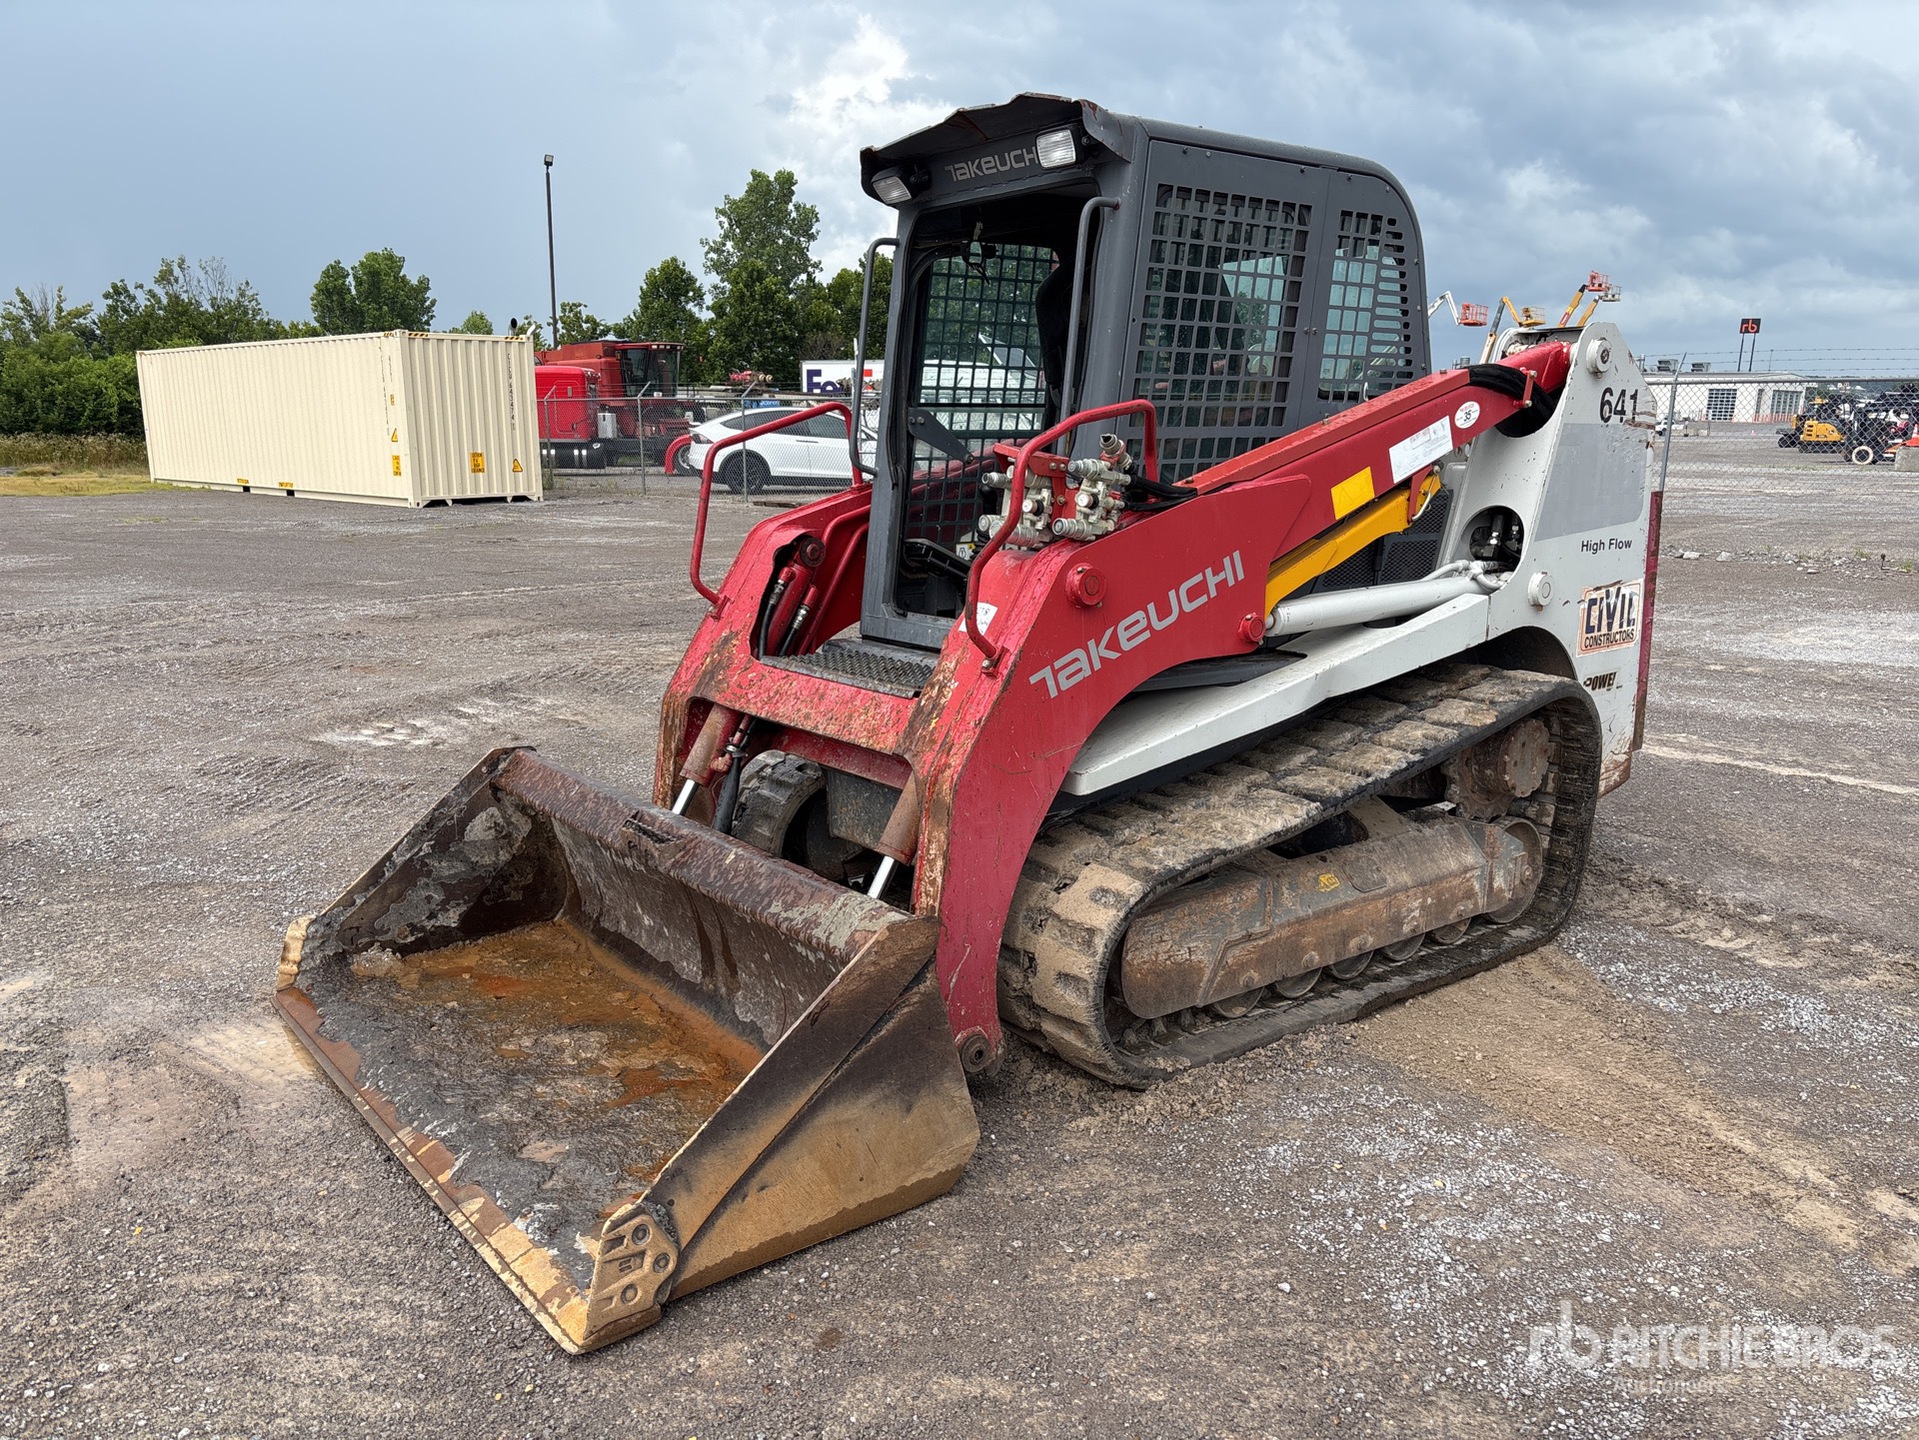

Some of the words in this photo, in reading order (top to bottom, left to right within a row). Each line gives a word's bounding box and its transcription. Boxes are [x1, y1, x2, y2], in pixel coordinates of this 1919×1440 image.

[944, 146, 1039, 182] TAKEUCH
[1741, 319, 1758, 333] rb
[1598, 386, 1640, 424] 641
[1580, 539, 1606, 555] High
[1608, 537, 1633, 551] Flow
[1585, 586, 1637, 635] CIVIL
[1584, 627, 1635, 649] CONSTRUCTORS
